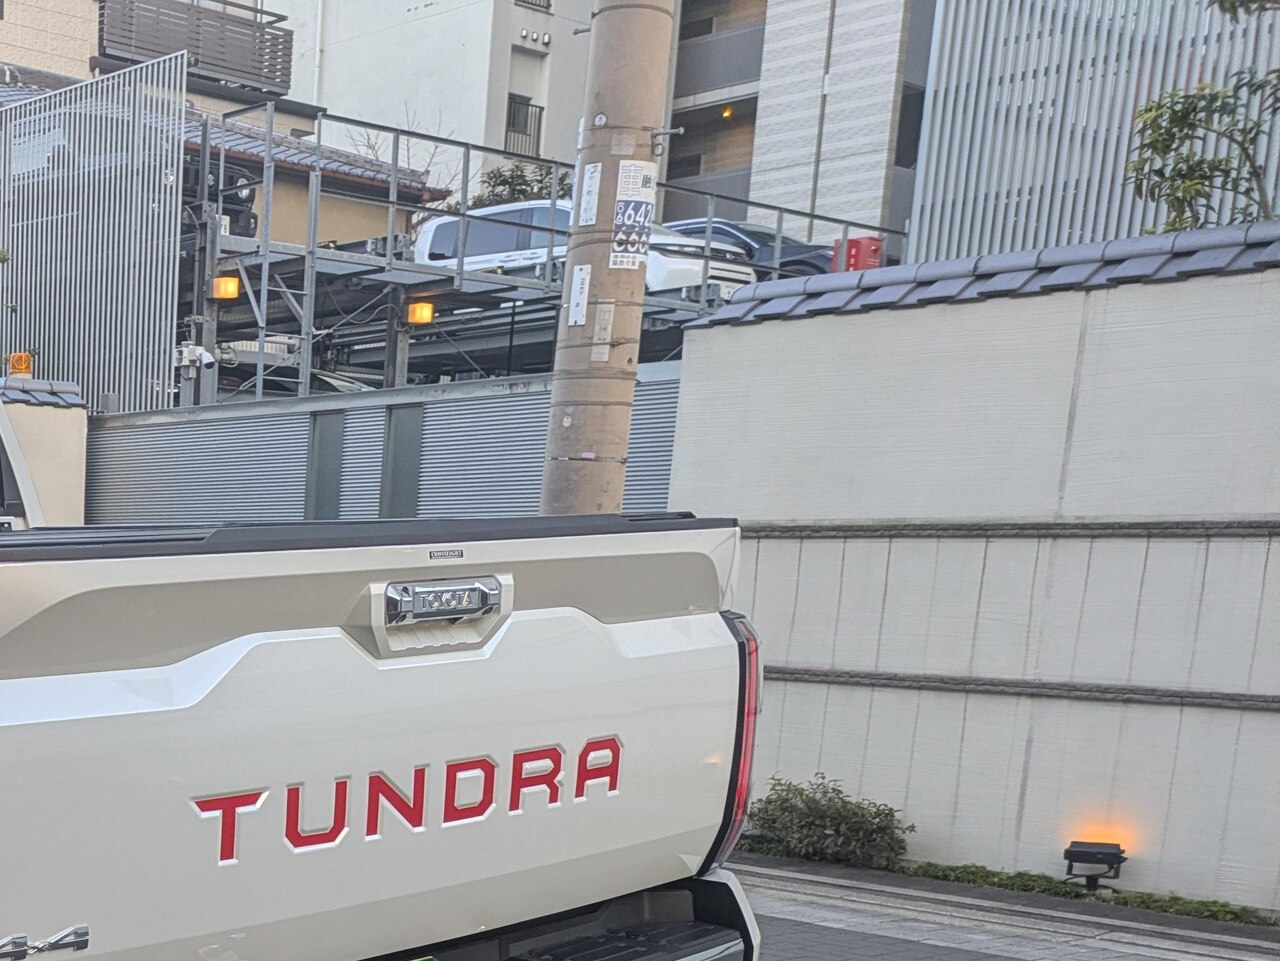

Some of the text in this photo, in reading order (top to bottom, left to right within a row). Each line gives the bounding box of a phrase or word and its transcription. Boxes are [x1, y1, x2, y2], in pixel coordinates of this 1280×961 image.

[618, 164, 642, 198] 車
[419, 591, 473, 610] TOYOTA
[191, 735, 623, 865] TUNDRA
